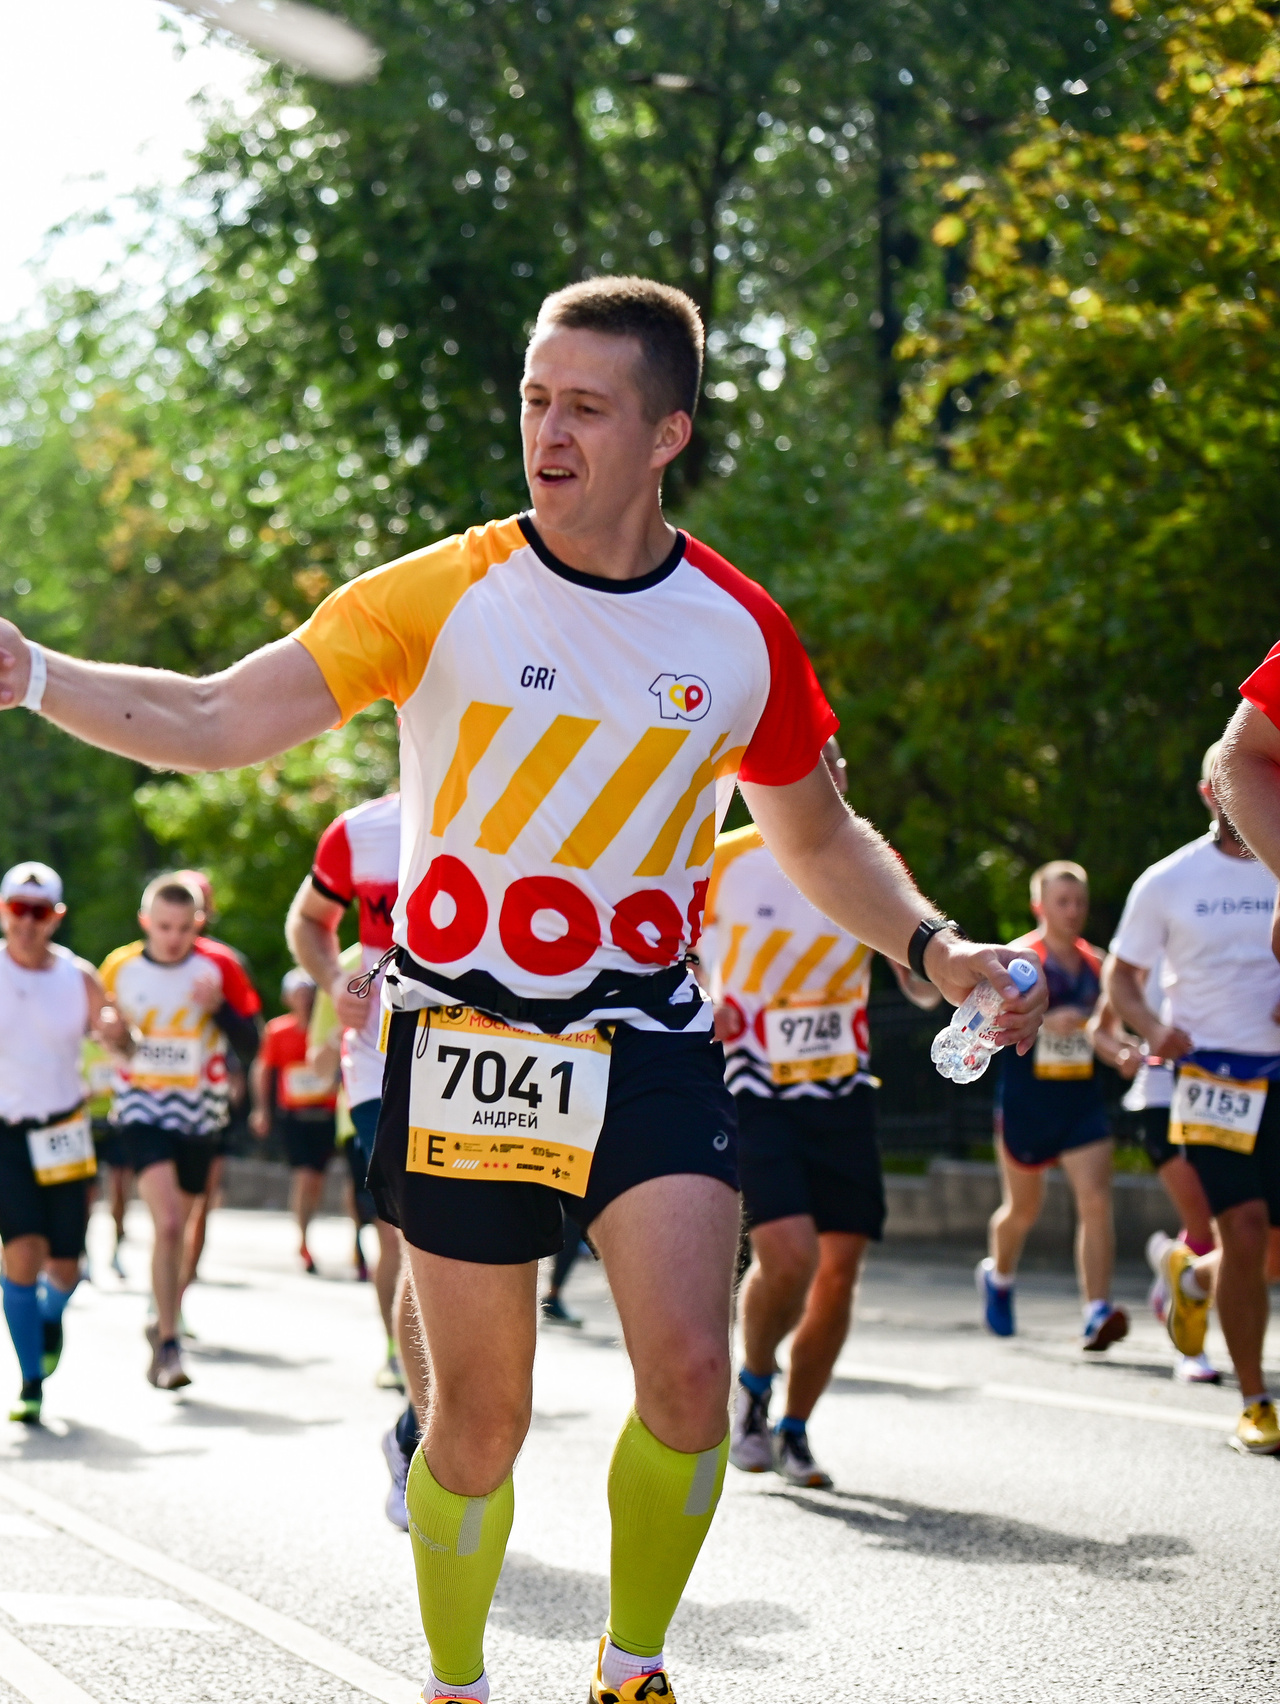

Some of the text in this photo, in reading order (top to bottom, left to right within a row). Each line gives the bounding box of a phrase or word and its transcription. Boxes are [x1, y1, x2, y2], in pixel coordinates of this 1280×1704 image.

[520, 665, 556, 691] GRi
[779, 1011, 842, 1045] 9748
[437, 1045, 574, 1115] 7041
[1187, 1083, 1251, 1118] 9153
[472, 1110, 538, 1129] АНДРЕЙ
[427, 1134, 446, 1167] E
